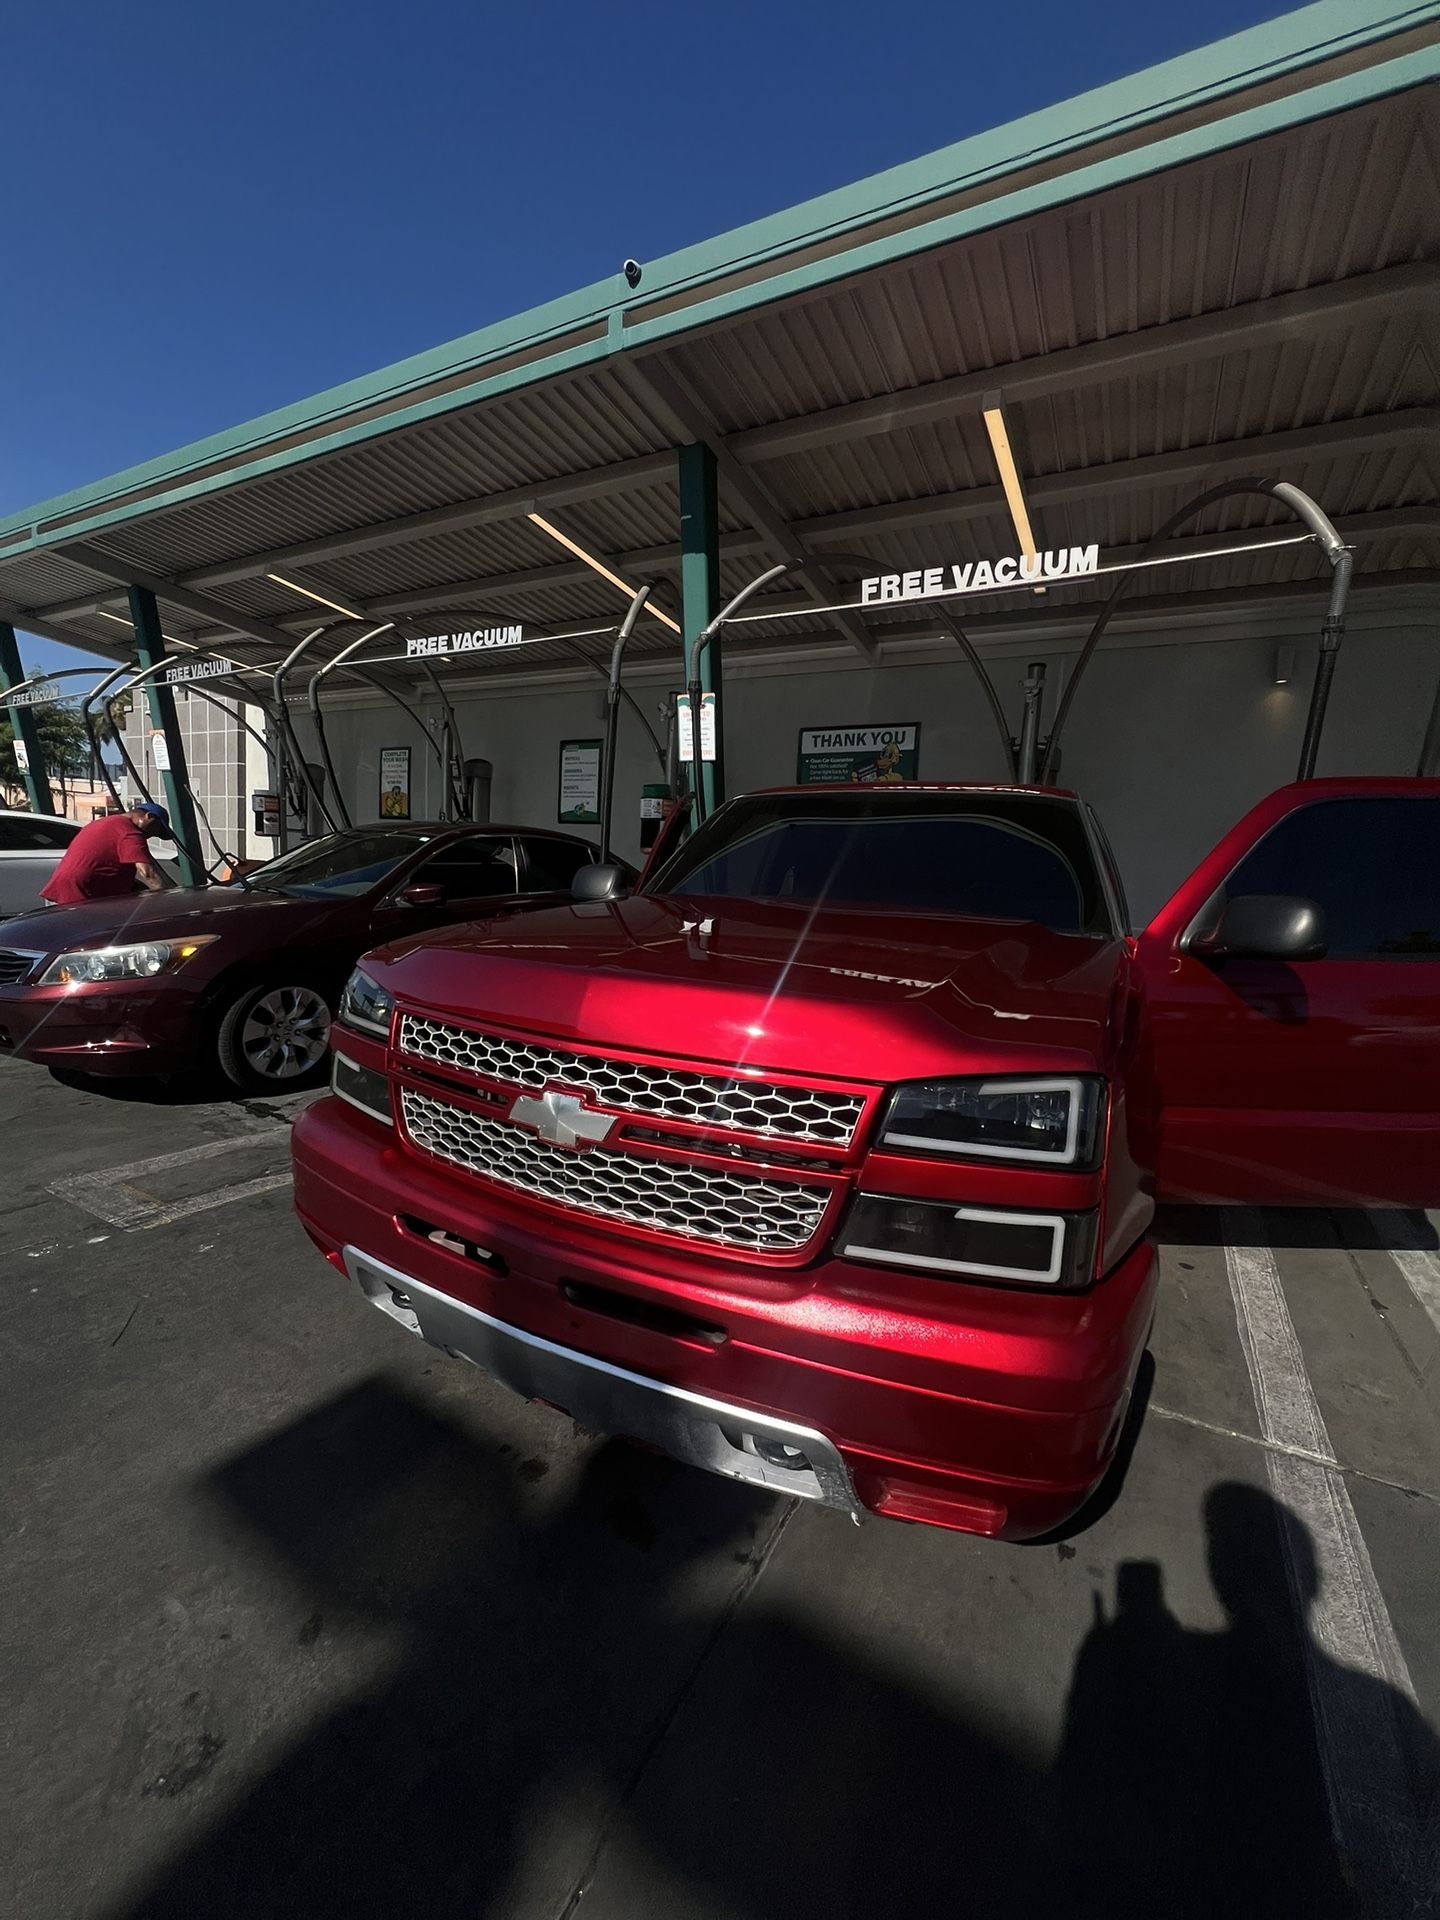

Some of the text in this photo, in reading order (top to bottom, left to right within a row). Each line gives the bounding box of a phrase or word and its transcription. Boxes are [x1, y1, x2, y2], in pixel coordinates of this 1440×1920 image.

[862, 544, 1099, 603] FREE VACUUM
[407, 625, 523, 656] FREE VACUUM
[166, 660, 232, 682] FREE VACUUM
[13, 691, 31, 705] FREE
[812, 730, 906, 748] THANK YOU
